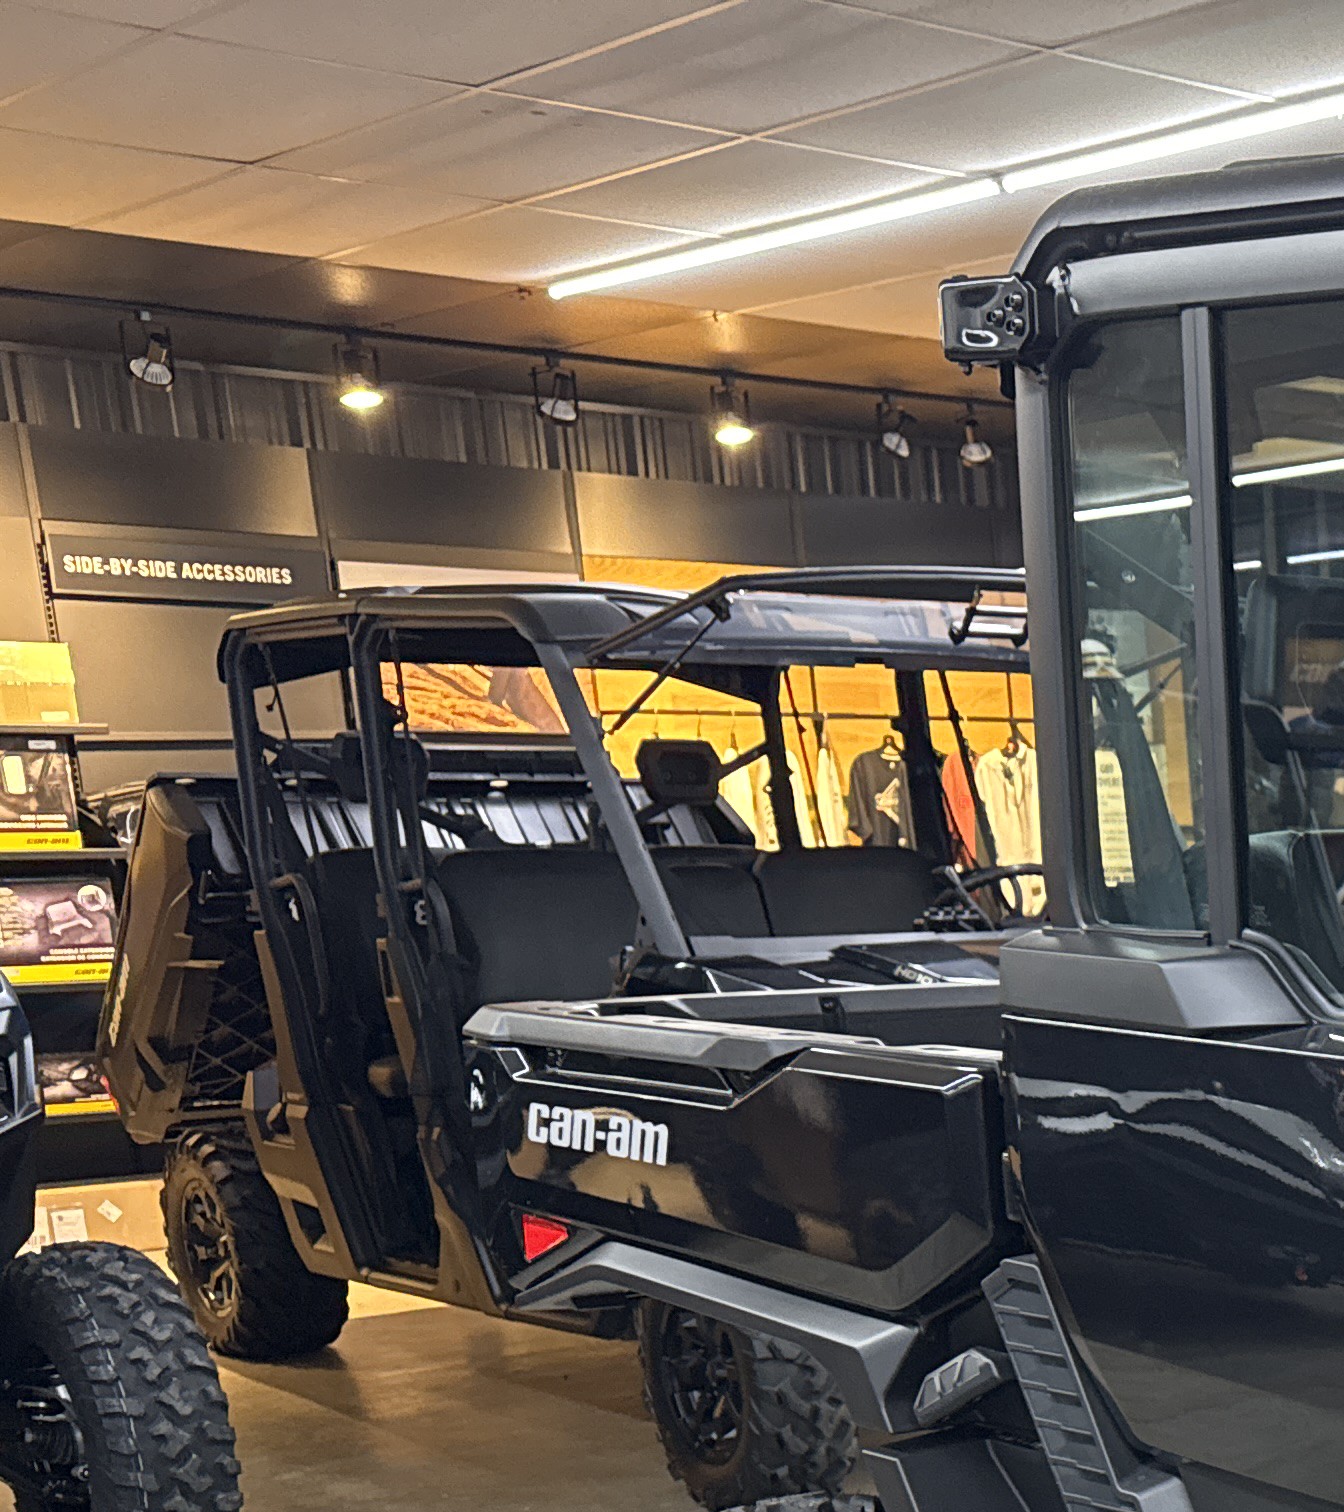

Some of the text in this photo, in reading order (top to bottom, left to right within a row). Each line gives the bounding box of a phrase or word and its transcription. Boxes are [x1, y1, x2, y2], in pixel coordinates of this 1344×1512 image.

[62, 553, 293, 586] SIDE-BY-SIDE ACCESSORIES
[527, 1101, 669, 1166] can-am
